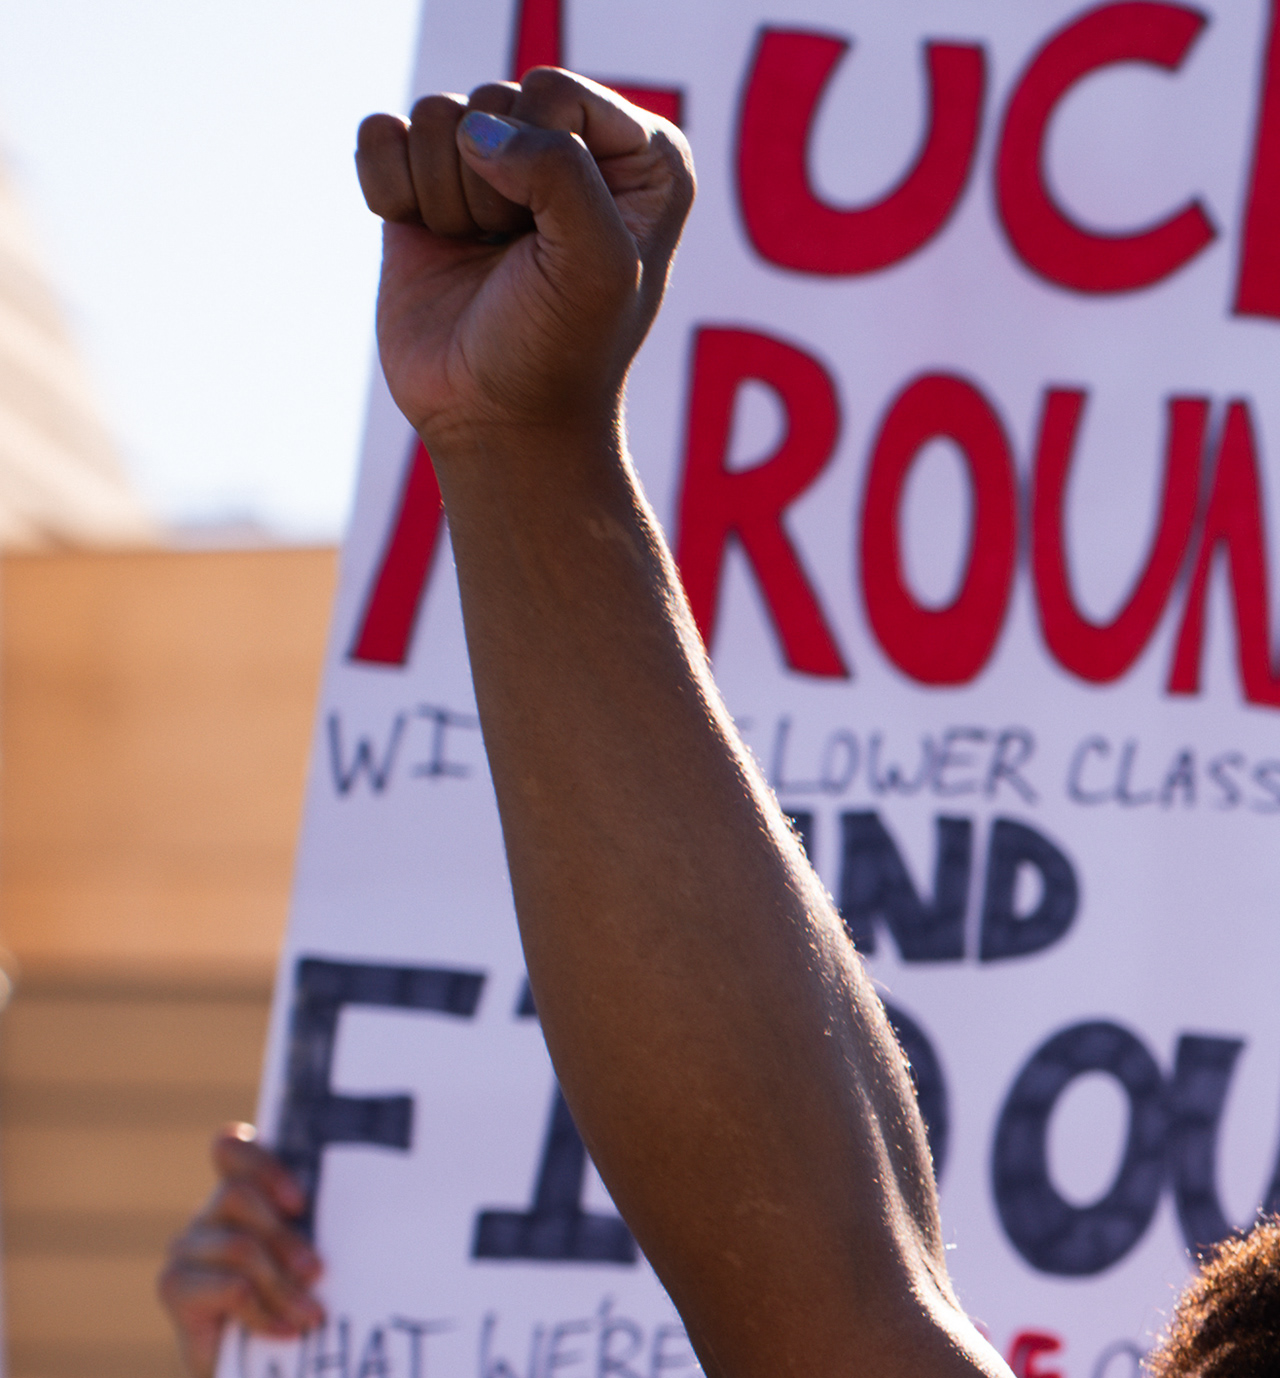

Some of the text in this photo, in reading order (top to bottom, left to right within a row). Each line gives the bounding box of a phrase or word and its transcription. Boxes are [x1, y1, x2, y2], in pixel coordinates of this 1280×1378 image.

[326, 703, 482, 800] WI
[773, 712, 1038, 805] LOWER
[783, 808, 1081, 966] ND
